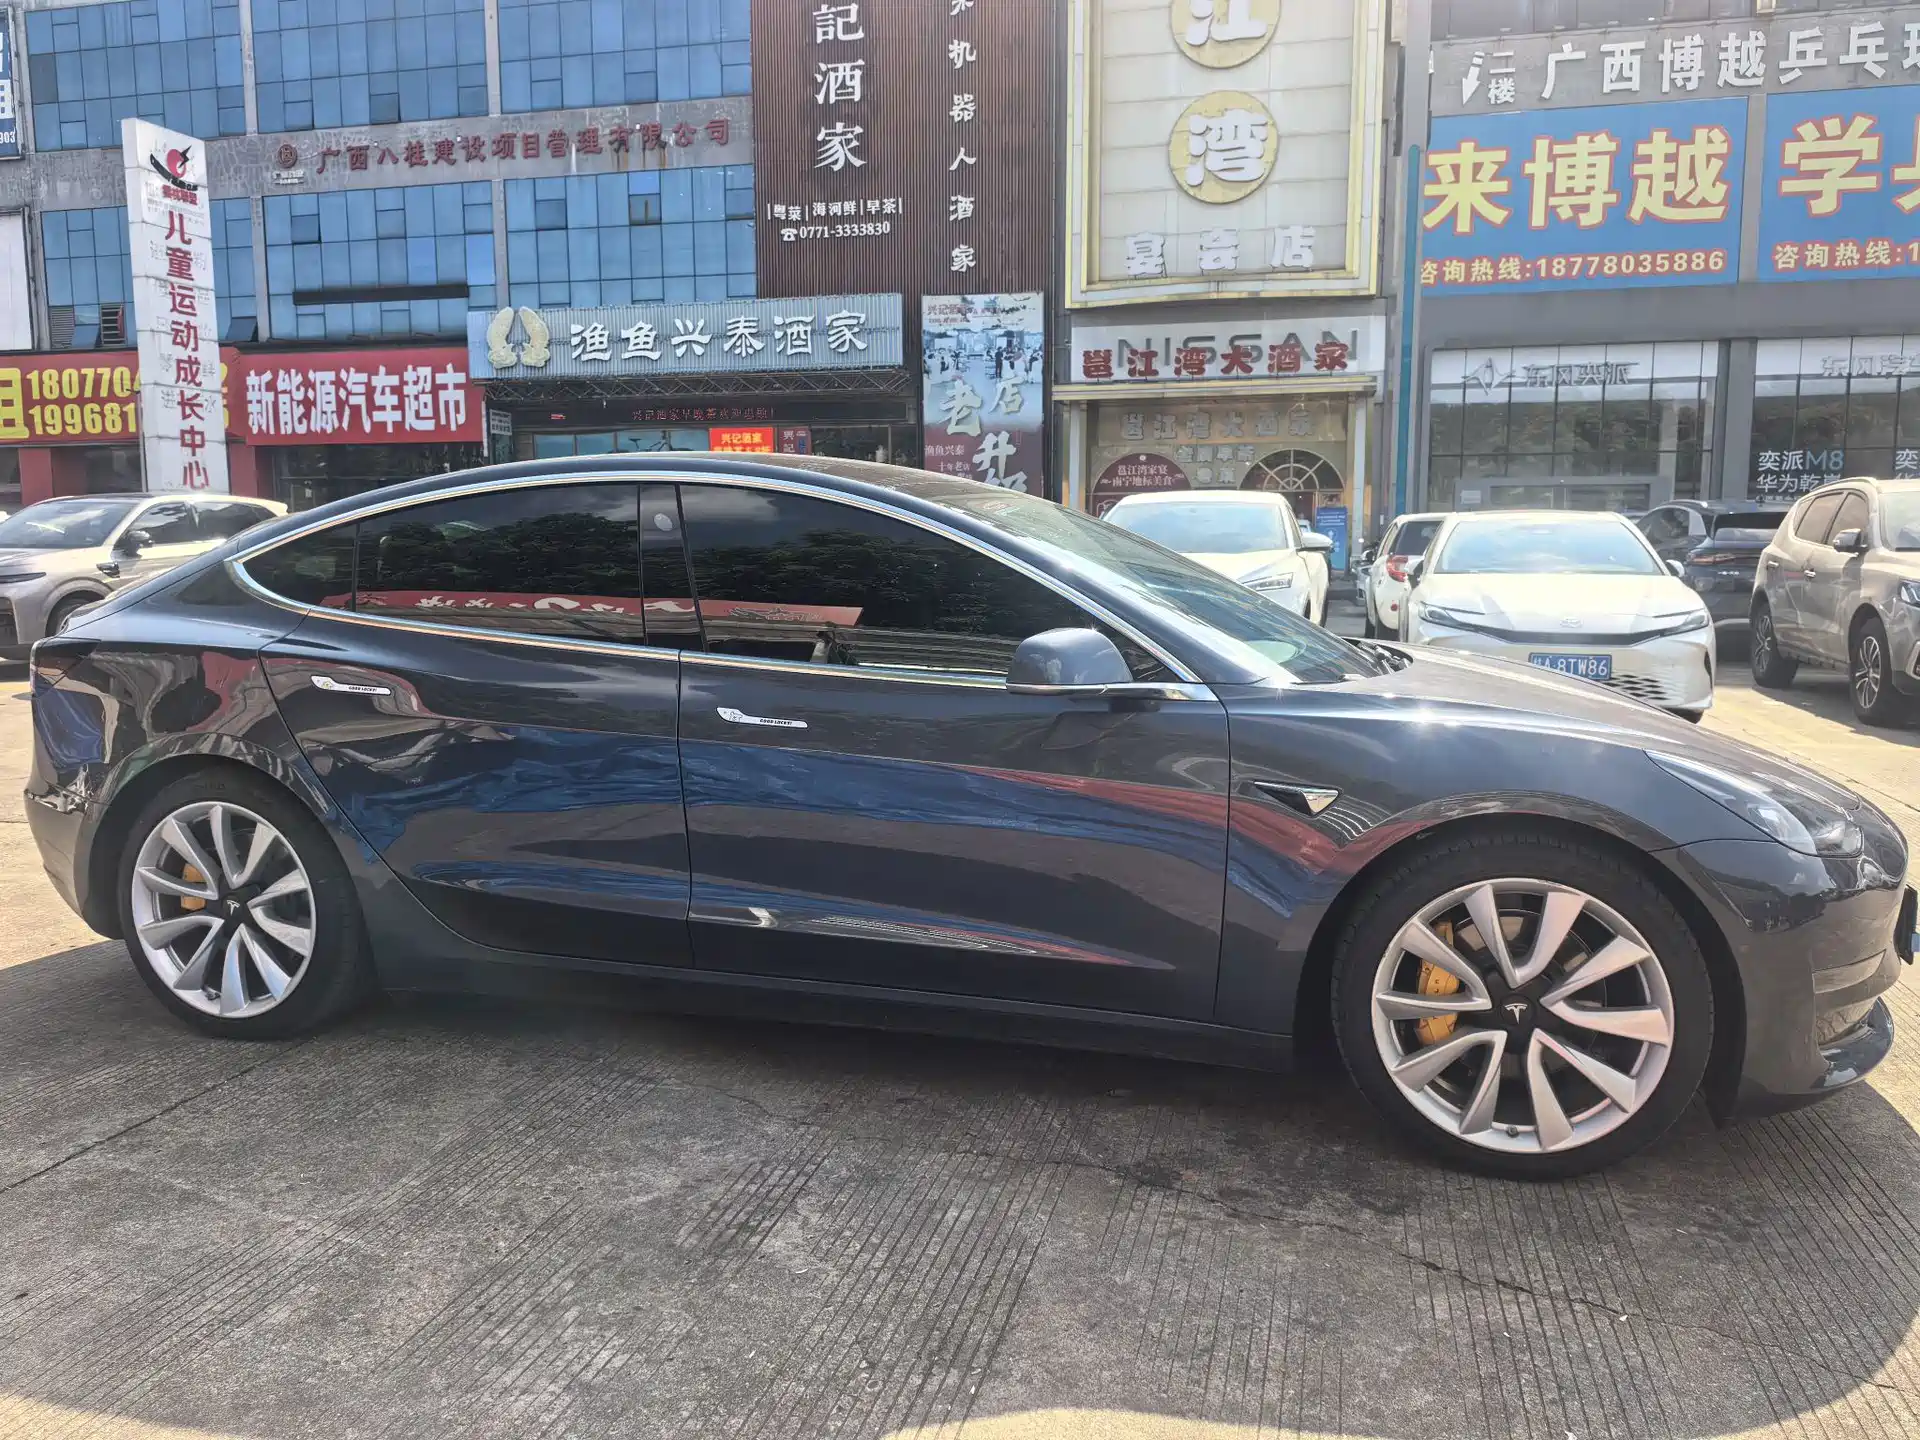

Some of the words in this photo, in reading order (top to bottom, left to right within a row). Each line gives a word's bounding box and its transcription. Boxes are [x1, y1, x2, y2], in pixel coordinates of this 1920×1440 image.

[812, 3, 867, 171] 記酒家
[316, 117, 731, 174] 广西八桂建设项目管理有限公司
[1781, 115, 1920, 216] 学
[1423, 128, 1729, 234] 来博越
[799, 220, 891, 239] 0771-3333830
[164, 210, 210, 490] 儿童运动成长中心
[570, 310, 869, 363] 渔鱼兴泰酒家
[1082, 342, 1350, 379] 邕江湾大酒家
[245, 363, 467, 436] 新能源汽车超市
[1758, 450, 1845, 471] 奕派M8
